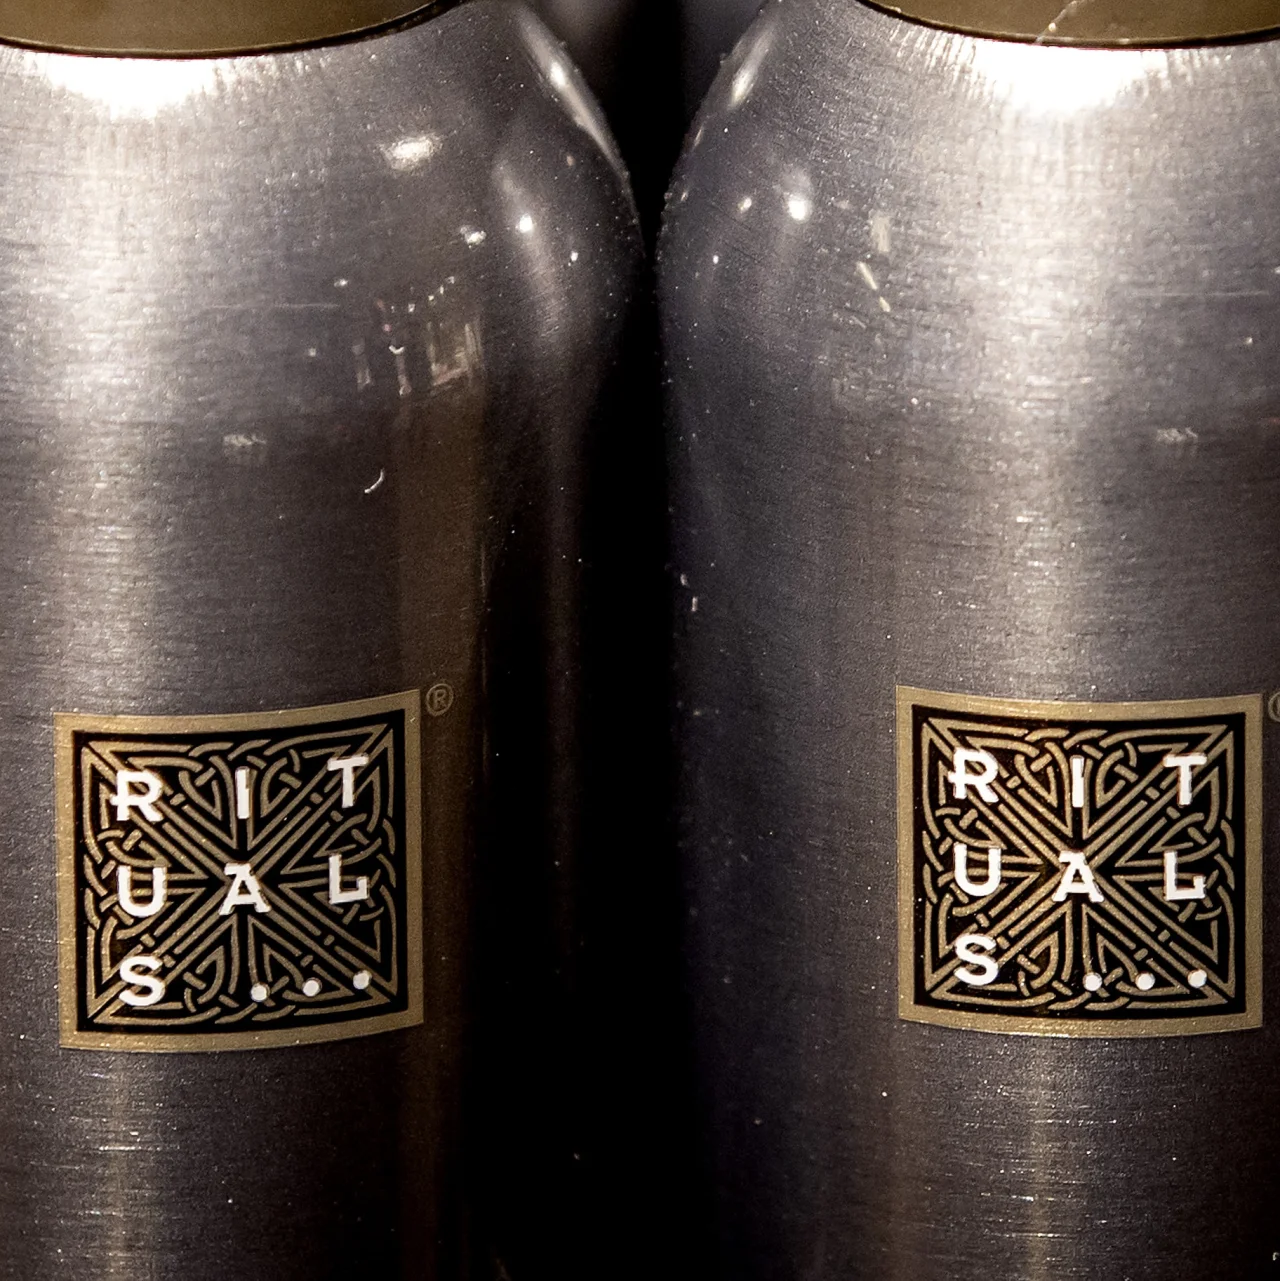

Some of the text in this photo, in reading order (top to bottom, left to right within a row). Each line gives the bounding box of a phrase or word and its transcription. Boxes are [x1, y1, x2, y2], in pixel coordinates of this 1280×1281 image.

[110, 755, 369, 822] RIT
[948, 747, 1207, 809] RIT
[117, 854, 370, 918] UAL
[954, 843, 1206, 903] UAL
